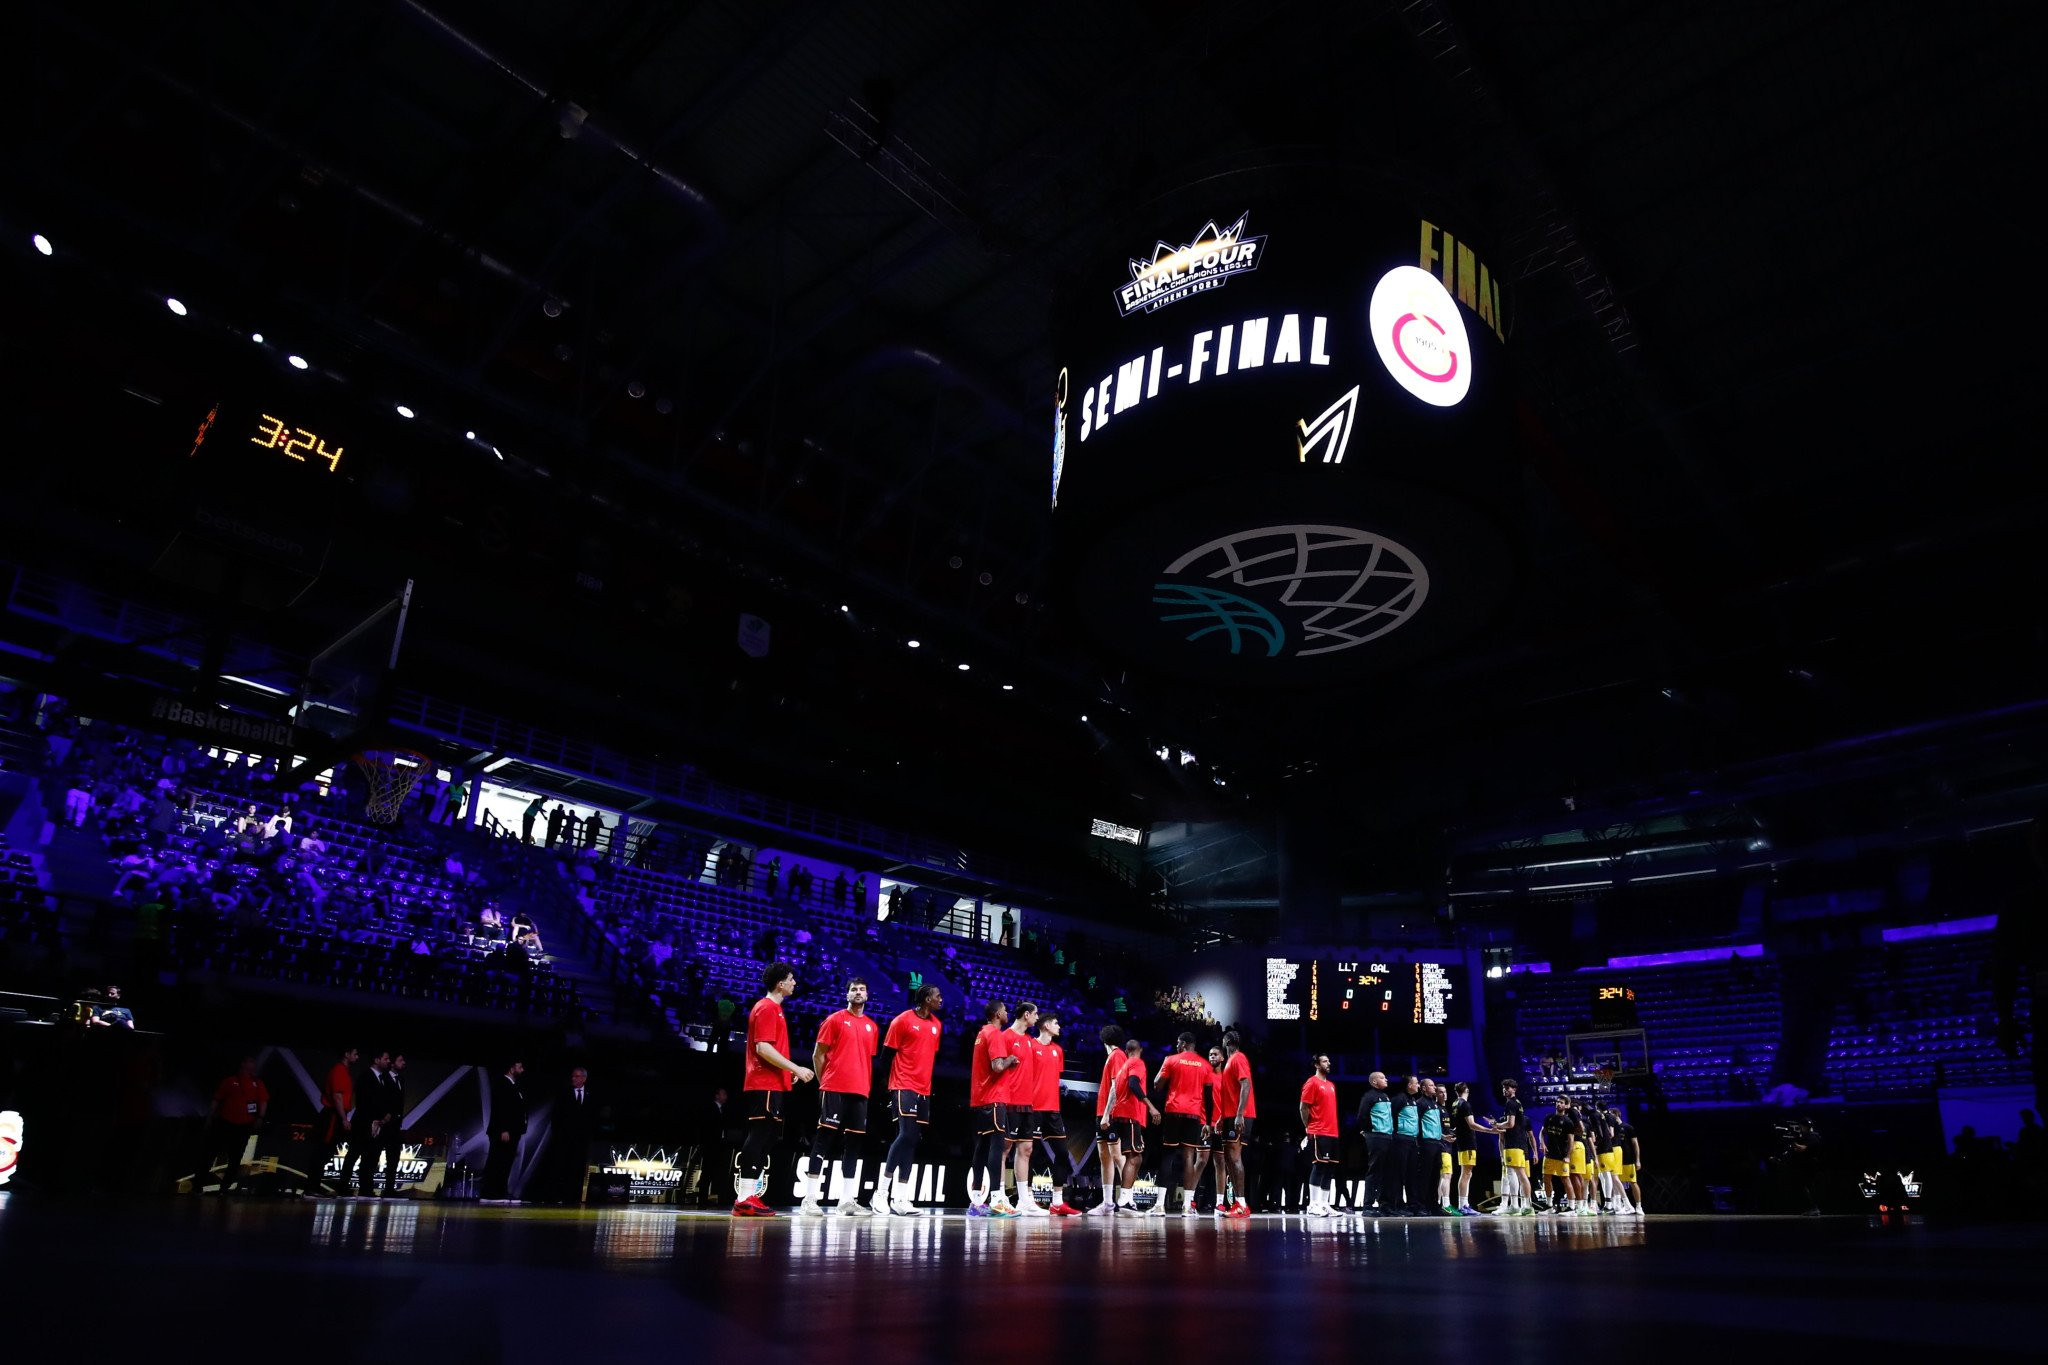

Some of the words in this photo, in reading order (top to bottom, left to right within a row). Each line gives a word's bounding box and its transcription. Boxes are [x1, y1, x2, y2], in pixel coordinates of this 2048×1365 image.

[1121, 262, 1185, 305] FINAL
[1188, 242, 1257, 275] FOUR
[1125, 286, 1170, 311] BASKETBALL
[1170, 267, 1218, 288] CHAMPIONS
[1219, 260, 1253, 272] LEAGUE
[1419, 219, 1505, 344] FINAL
[1153, 289, 1188, 309] ATHENS
[1192, 279, 1219, 293] 2025
[1081, 314, 1331, 442] SEMI-FINAL
[250, 413, 342, 472] 3:24
[151, 696, 296, 748] #BasketballCL
[1338, 962, 1359, 972] LLT
[1371, 963, 1390, 973] GAL
[1342, 1001, 1349, 1009] 0
[1382, 1002, 1389, 1010] 0
[1346, 989, 1354, 999] 0
[1385, 990, 1392, 1000] 0
[1599, 987, 1624, 1000] 3:24
[1179, 1059, 1202, 1067] DELGADO
[646, 1169, 683, 1181] FOUR
